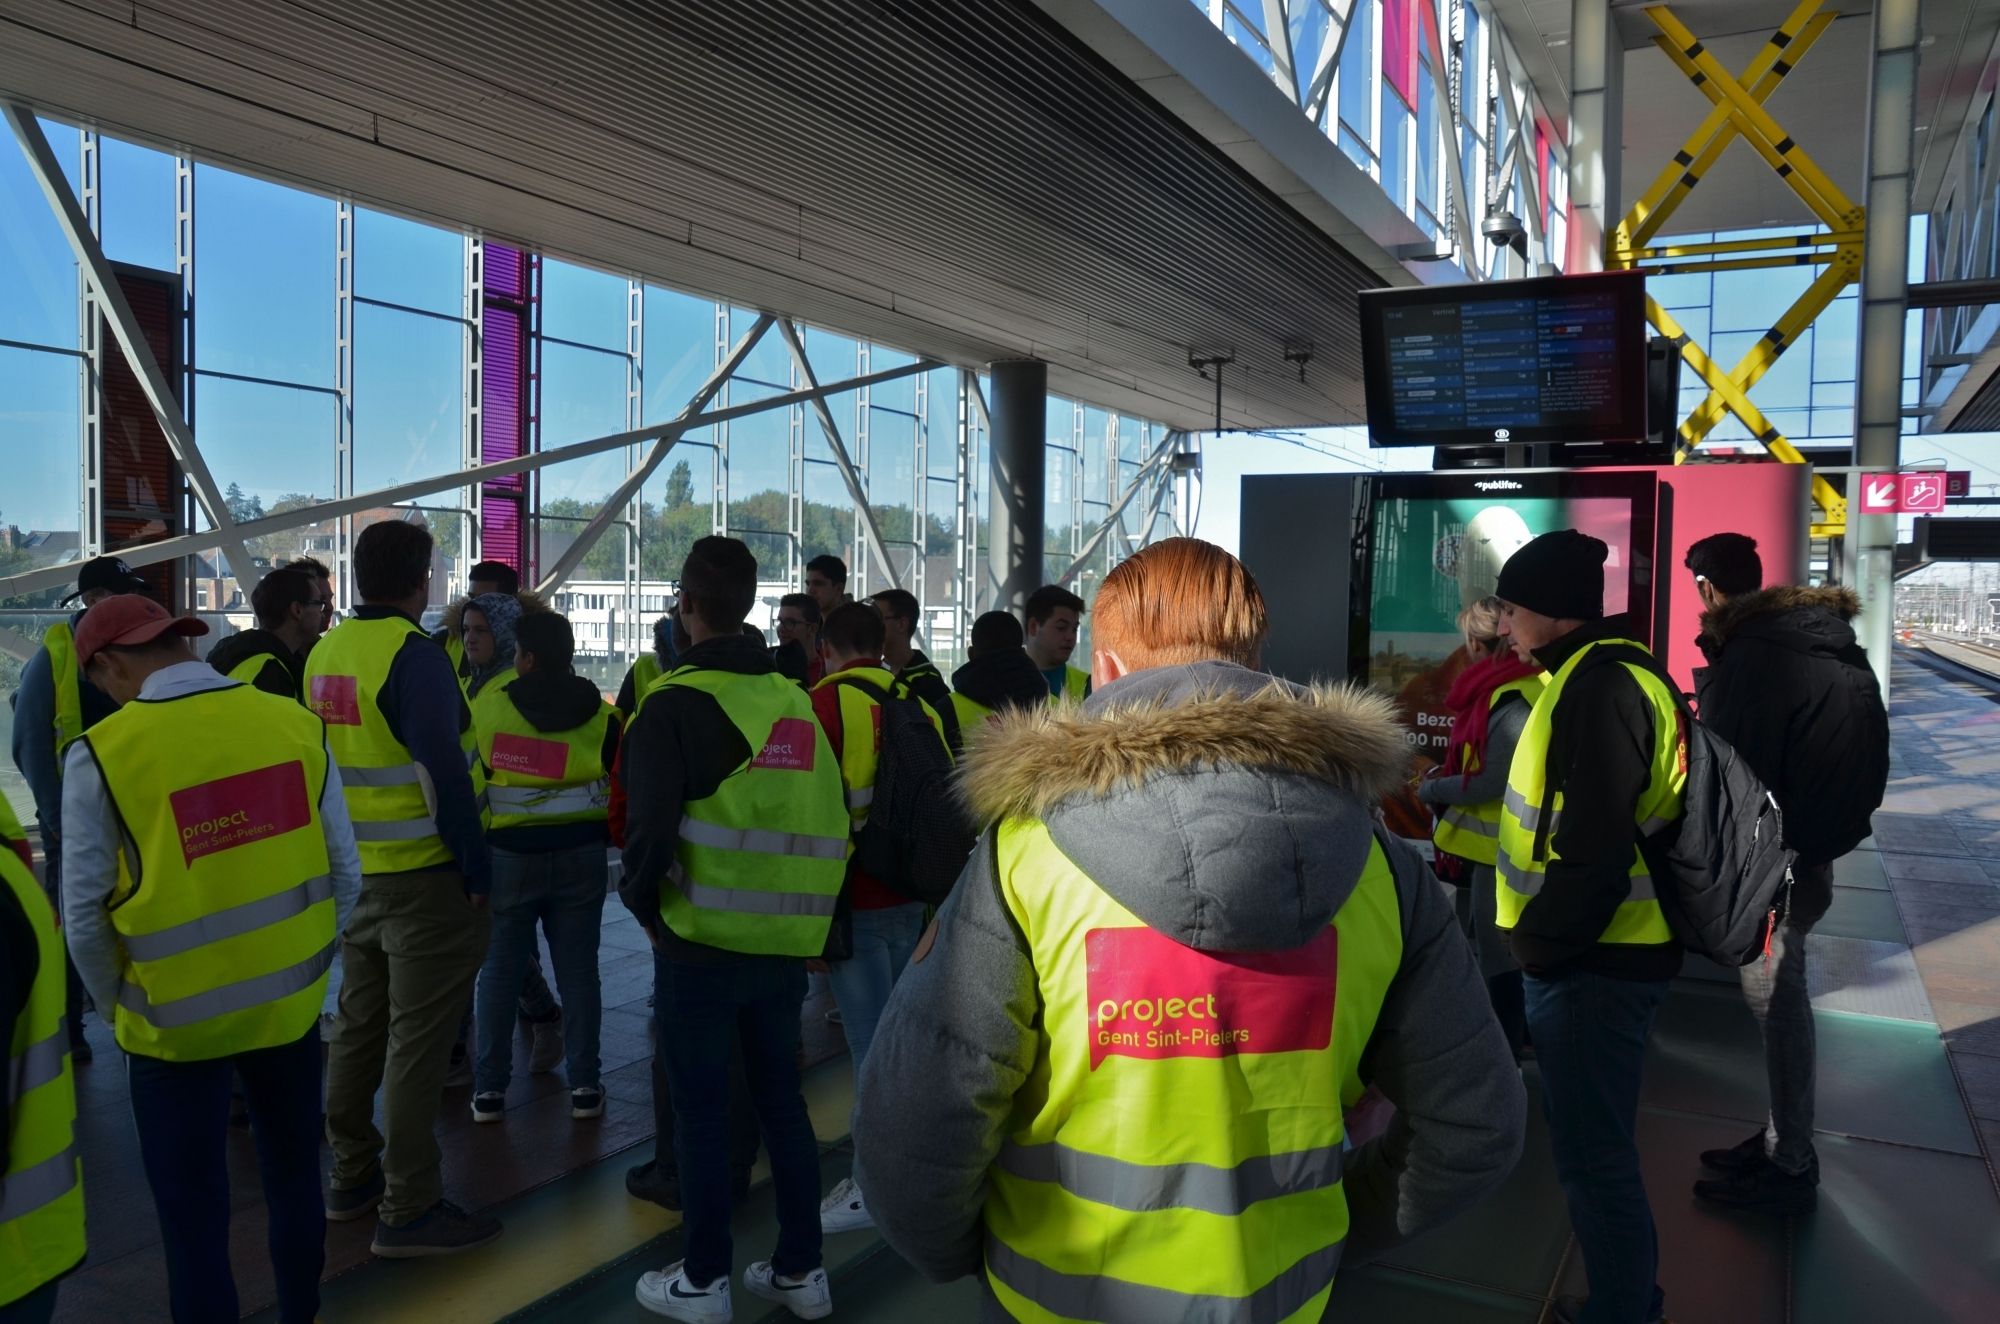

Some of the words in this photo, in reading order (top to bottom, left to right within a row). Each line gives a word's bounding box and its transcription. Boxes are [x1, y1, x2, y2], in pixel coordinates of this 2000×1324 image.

[492, 751, 529, 764] project
[183, 809, 249, 843] project
[186, 840, 209, 854] Gent
[211, 823, 275, 847] Sint-Pieters
[1097, 993, 1218, 1028] project
[1098, 1031, 1140, 1046] Gent
[1146, 1028, 1250, 1048] Sint-Pieters
